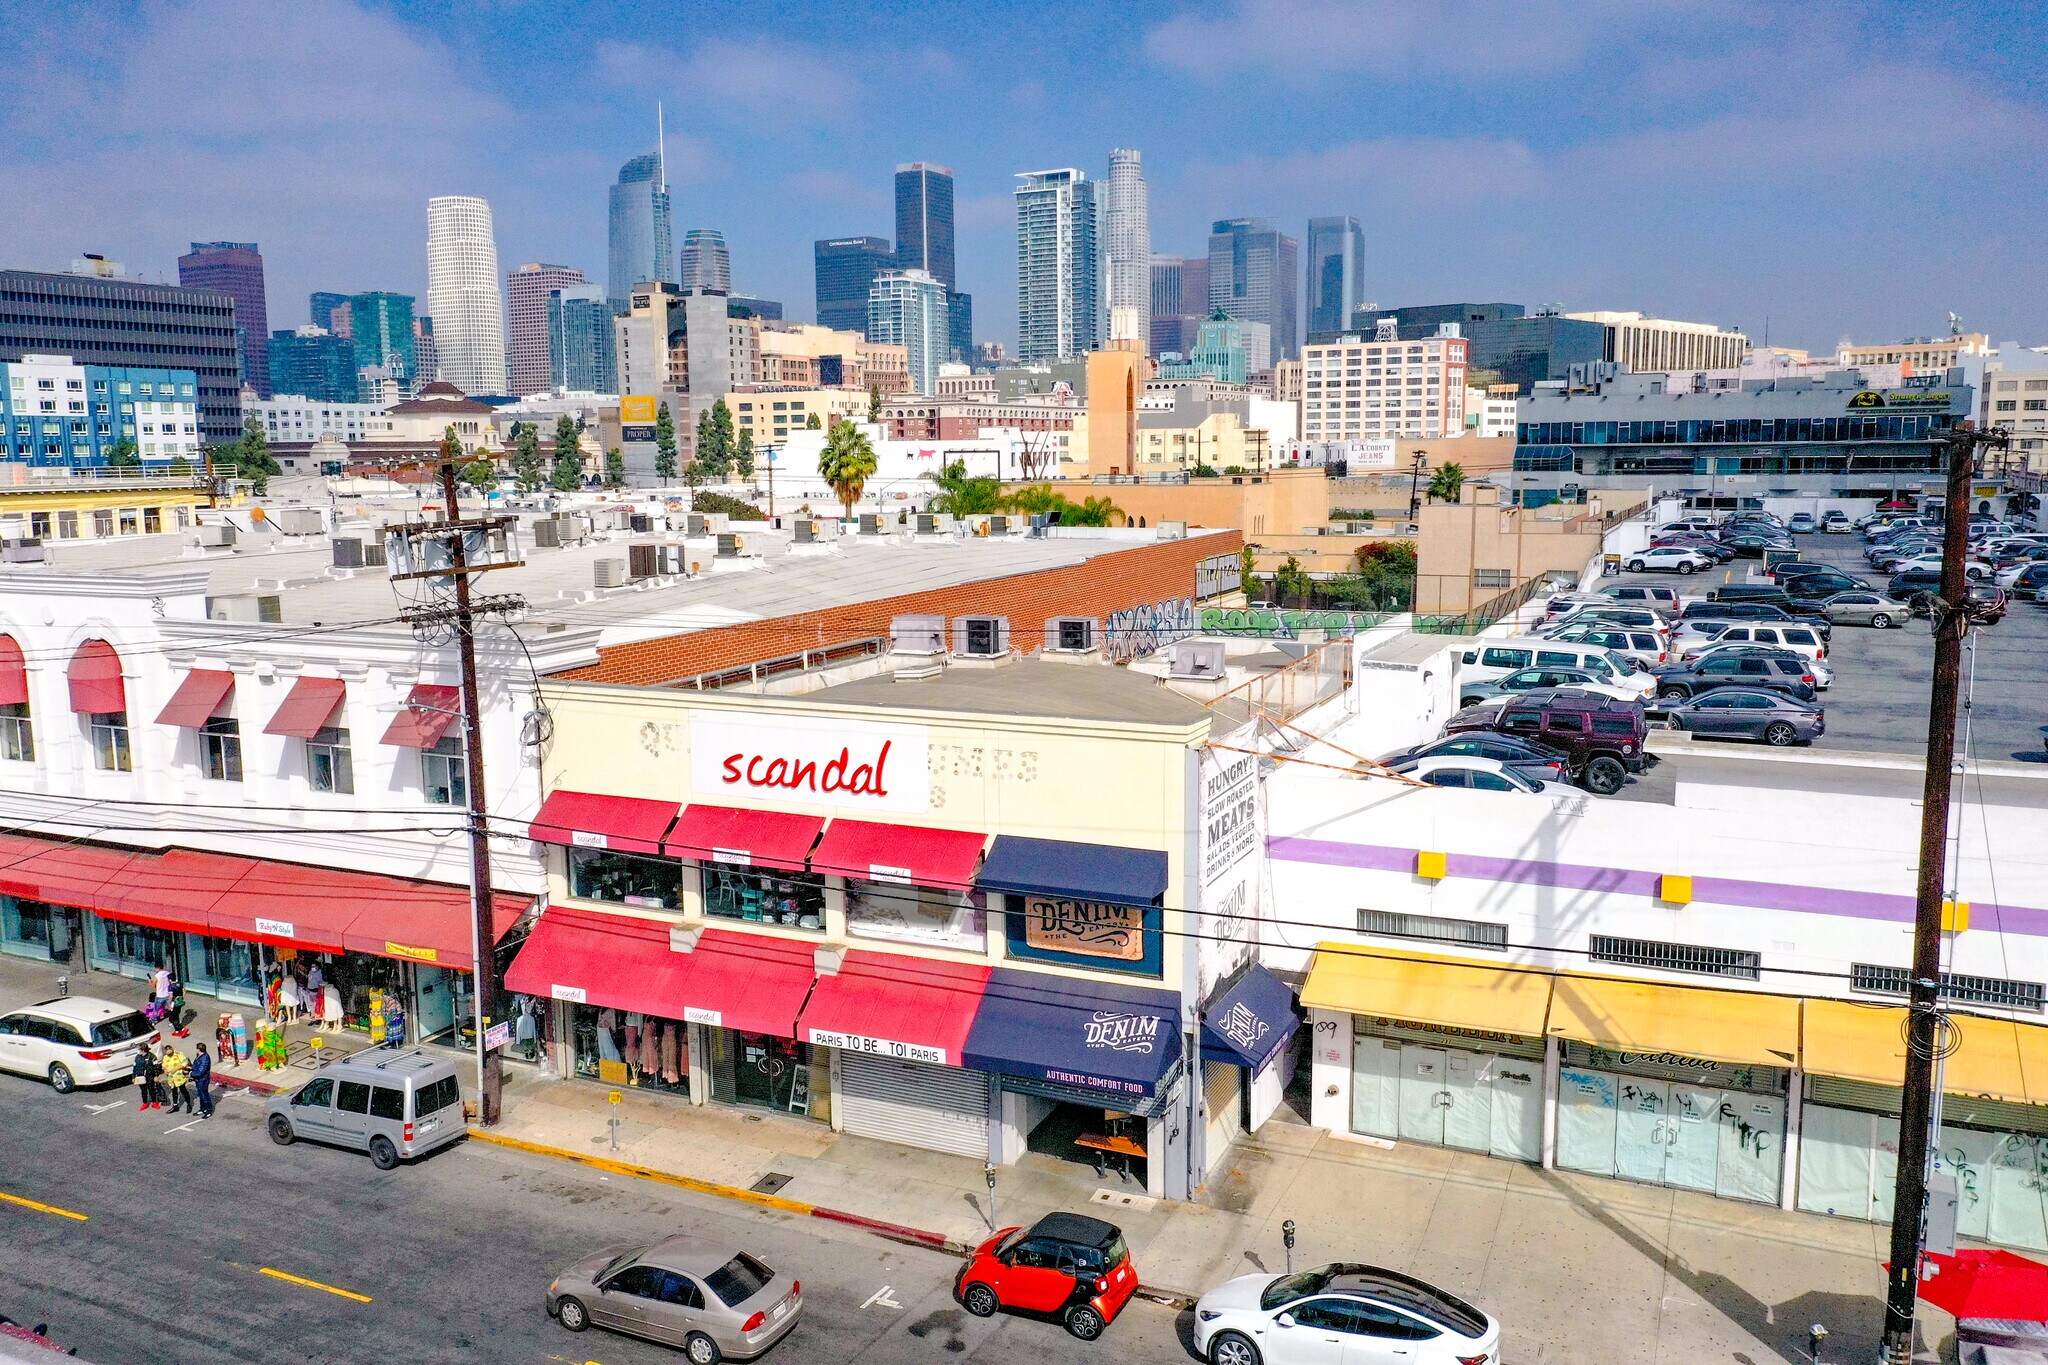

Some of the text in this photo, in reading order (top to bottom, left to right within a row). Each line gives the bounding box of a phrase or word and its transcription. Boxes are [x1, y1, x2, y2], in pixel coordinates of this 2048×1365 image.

[627, 430, 652, 438] PROPER
[1358, 452, 1384, 460] JEANS
[1366, 444, 1391, 452] COUNTY
[721, 739, 892, 797] scandal
[1207, 754, 1254, 798] HUNGRY?
[1207, 801, 1225, 820] SLOW
[1207, 795, 1254, 849] MEATS
[1206, 852, 1230, 879] DRINKS
[1032, 900, 1130, 936] DENIM
[556, 990, 581, 1000] scandal
[688, 1011, 715, 1022] scandal
[1227, 1001, 1256, 1048] DENIM
[1083, 1015, 1160, 1046] DENIM
[1122, 1036, 1151, 1044] EATERY
[816, 1033, 842, 1047] PARIS
[846, 1035, 860, 1049] TO
[889, 1042, 907, 1057] TOI
[911, 1048, 939, 1062] PARIS
[1046, 1069, 1143, 1094] AUTHENTIC COMFORT FOOD
